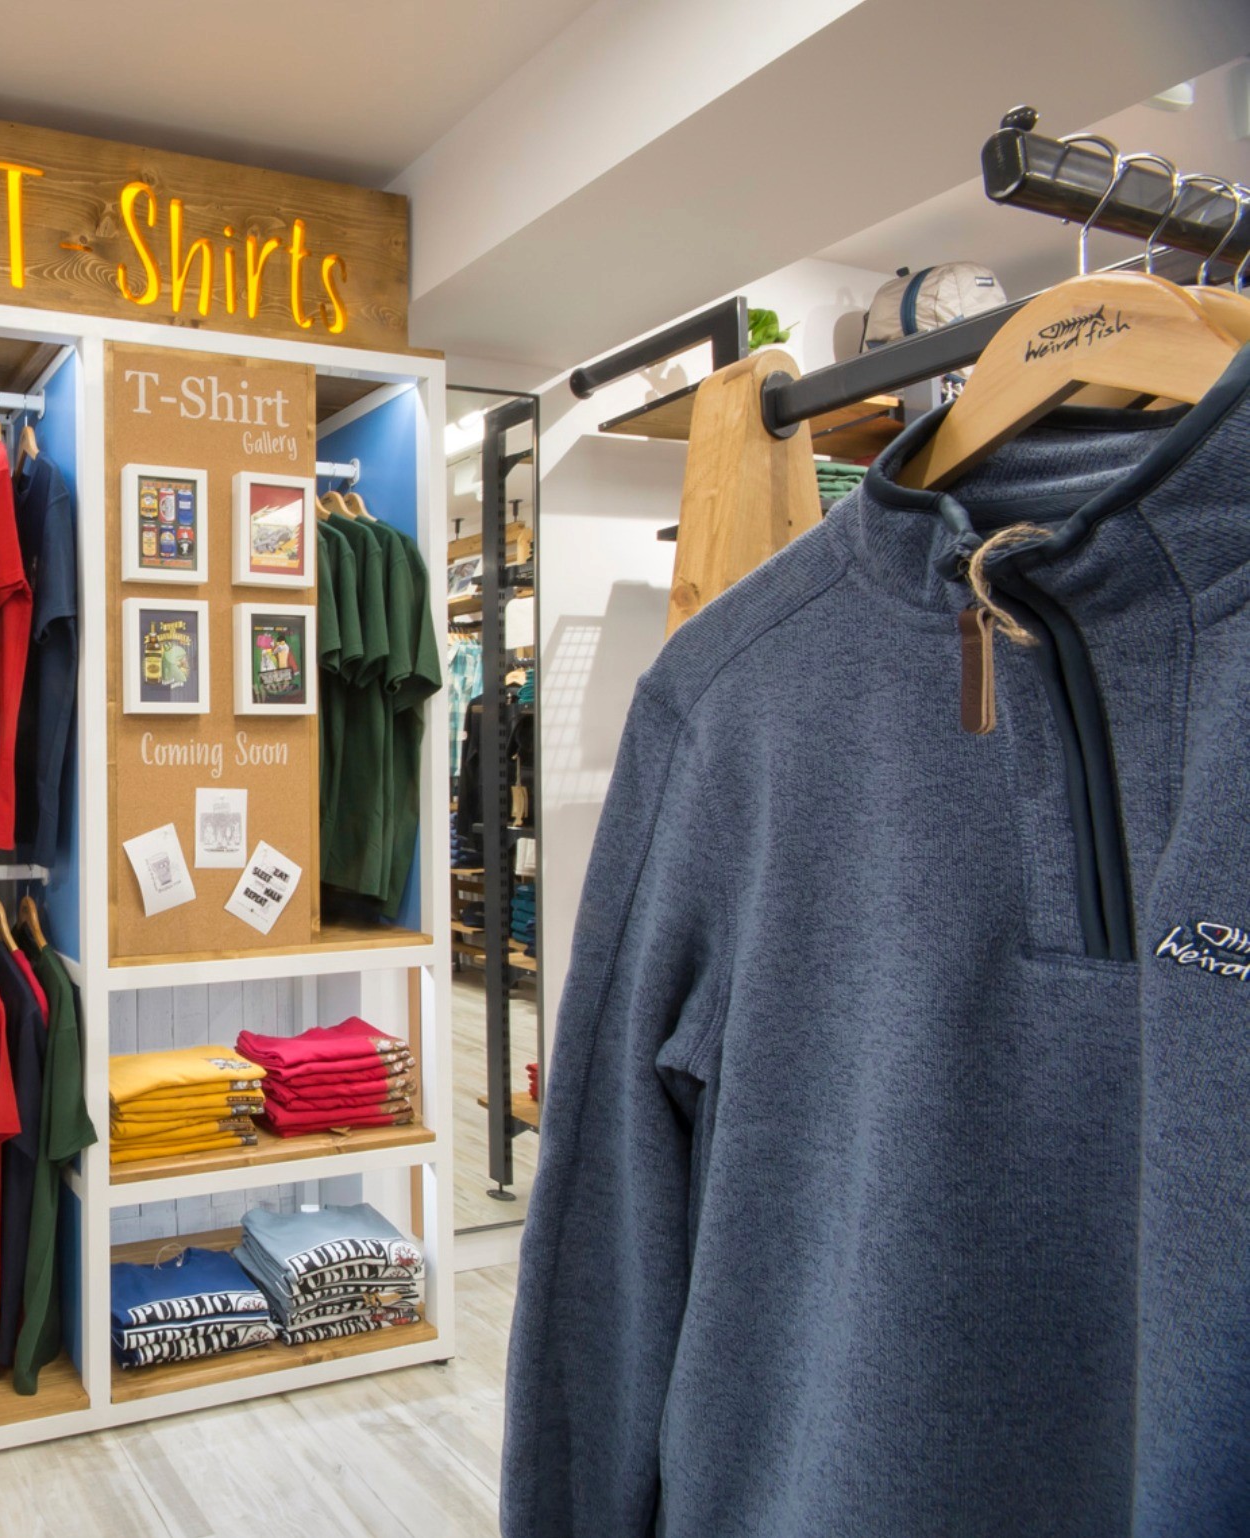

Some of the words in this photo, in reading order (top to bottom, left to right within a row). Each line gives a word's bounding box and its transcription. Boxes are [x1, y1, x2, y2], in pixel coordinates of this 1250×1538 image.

[124, 370, 290, 428] T-Shirt
[242, 431, 298, 461] Gallery
[141, 732, 224, 779] Coming
[235, 731, 288, 766] Soon
[290, 1239, 385, 1274] PUBLIC
[134, 1293, 233, 1325] PUBLIC
